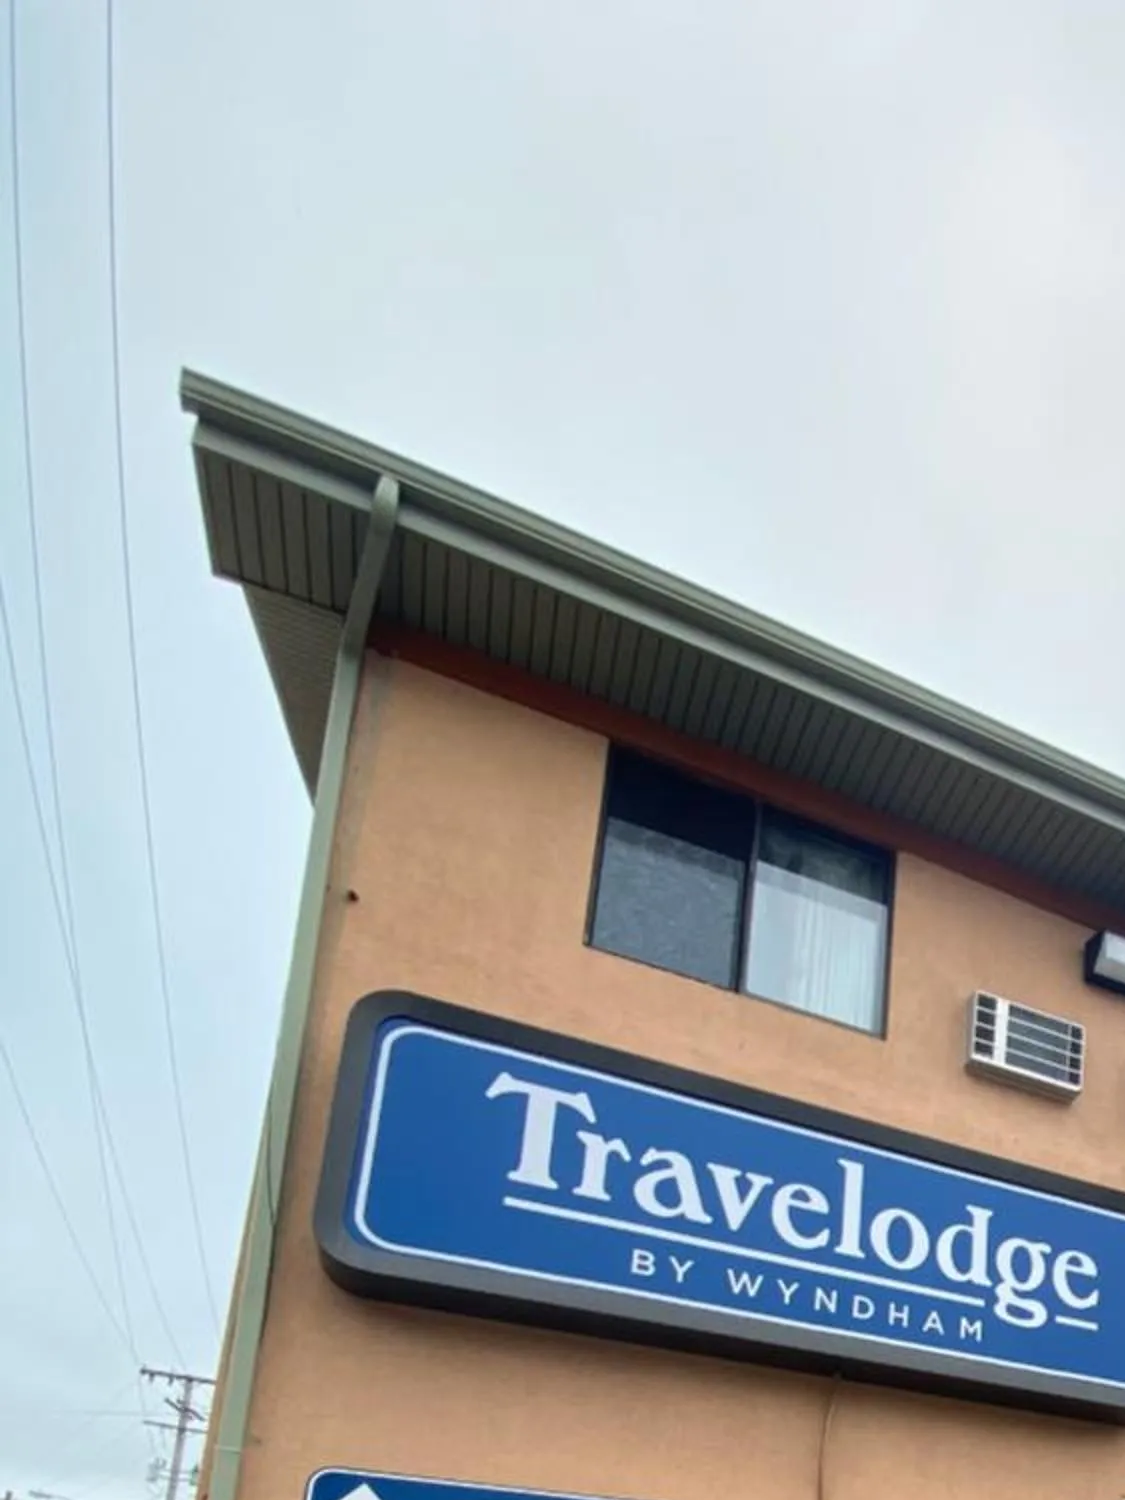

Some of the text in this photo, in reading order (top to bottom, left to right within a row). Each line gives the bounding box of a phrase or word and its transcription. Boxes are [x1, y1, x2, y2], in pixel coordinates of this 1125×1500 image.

[485, 1072, 1099, 1328] Travelodge
[630, 1247, 983, 1341] BY WYNDHAM
